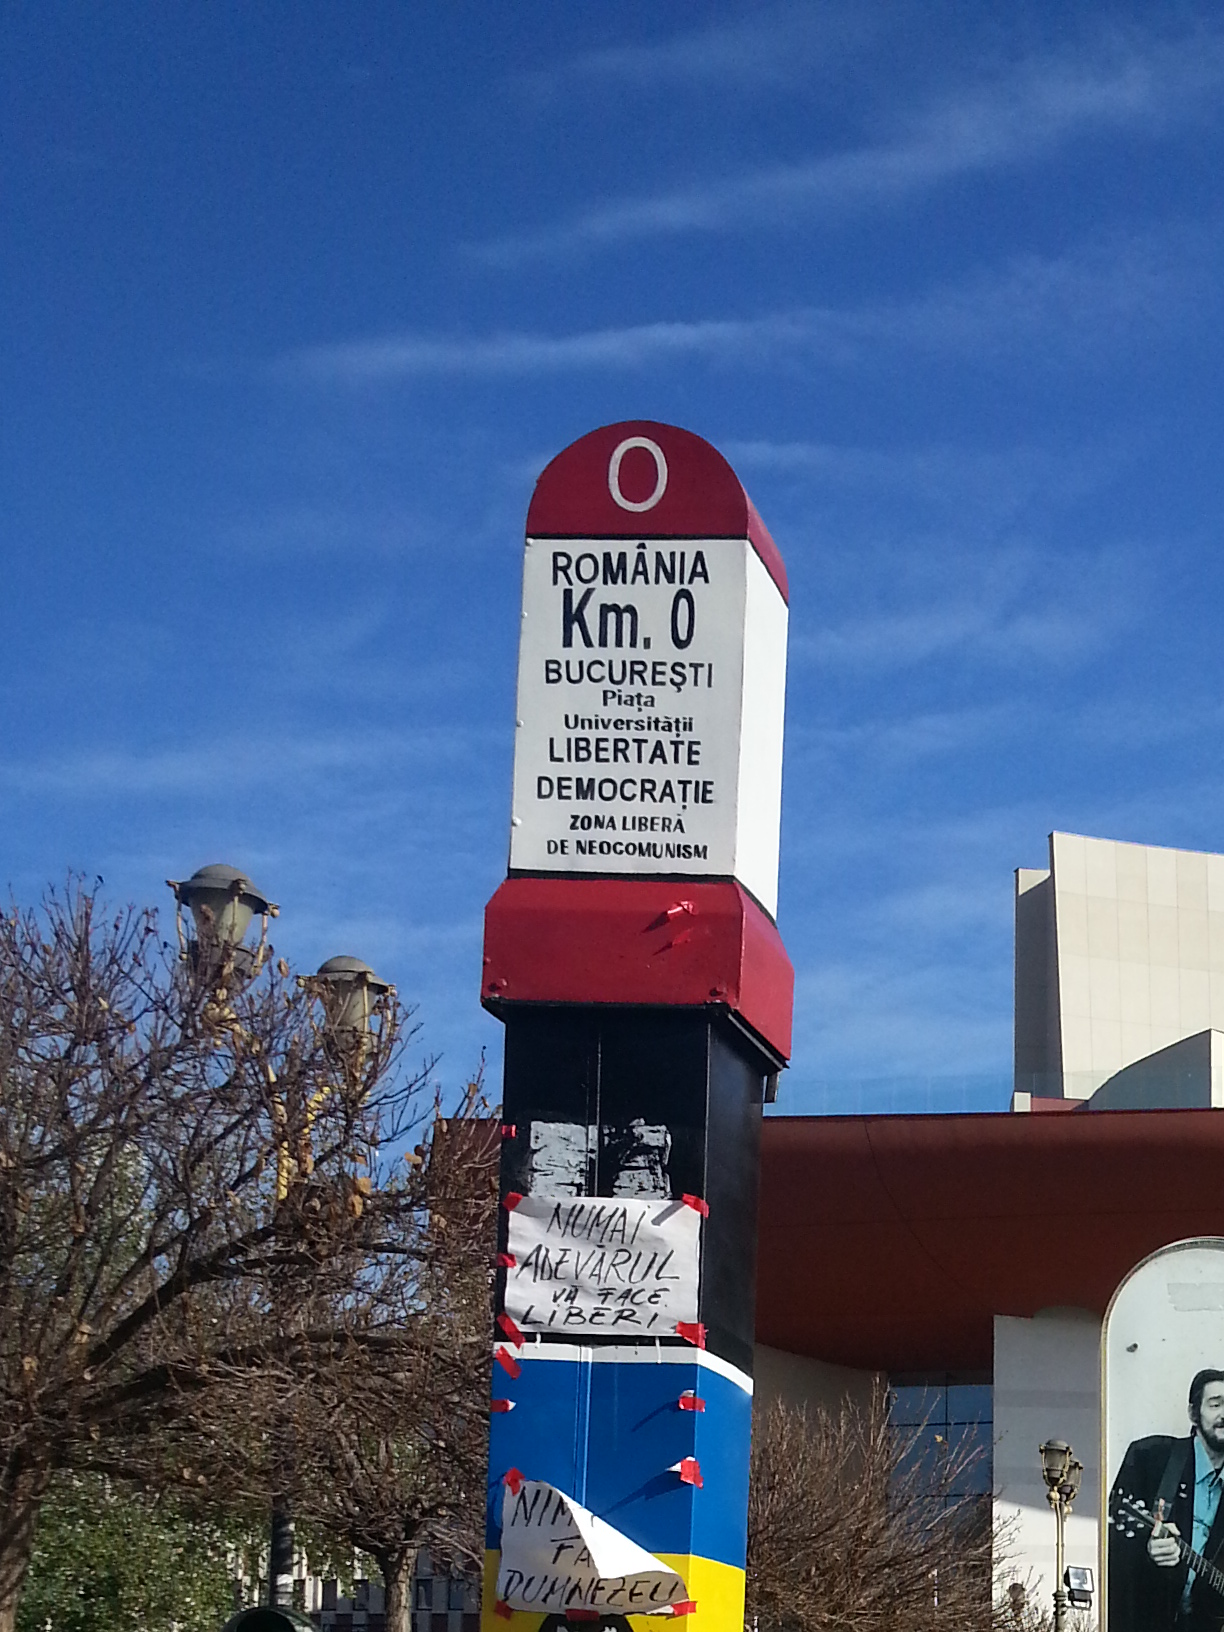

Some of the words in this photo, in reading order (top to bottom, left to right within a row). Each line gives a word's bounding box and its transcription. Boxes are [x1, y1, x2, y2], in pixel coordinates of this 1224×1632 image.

[551, 542, 710, 586] ROMÂNIA
[562, 587, 651, 650] Km.
[670, 588, 695, 650] 0
[602, 689, 656, 712] Piața
[548, 737, 702, 766] LIBERTATE
[537, 775, 715, 810] DEMOCRAȚIE
[569, 814, 617, 831] ZONA
[546, 839, 569, 855] DE
[576, 839, 708, 860] NEOCOMUNISM
[504, 1569, 680, 1608] DUMNEZEU
